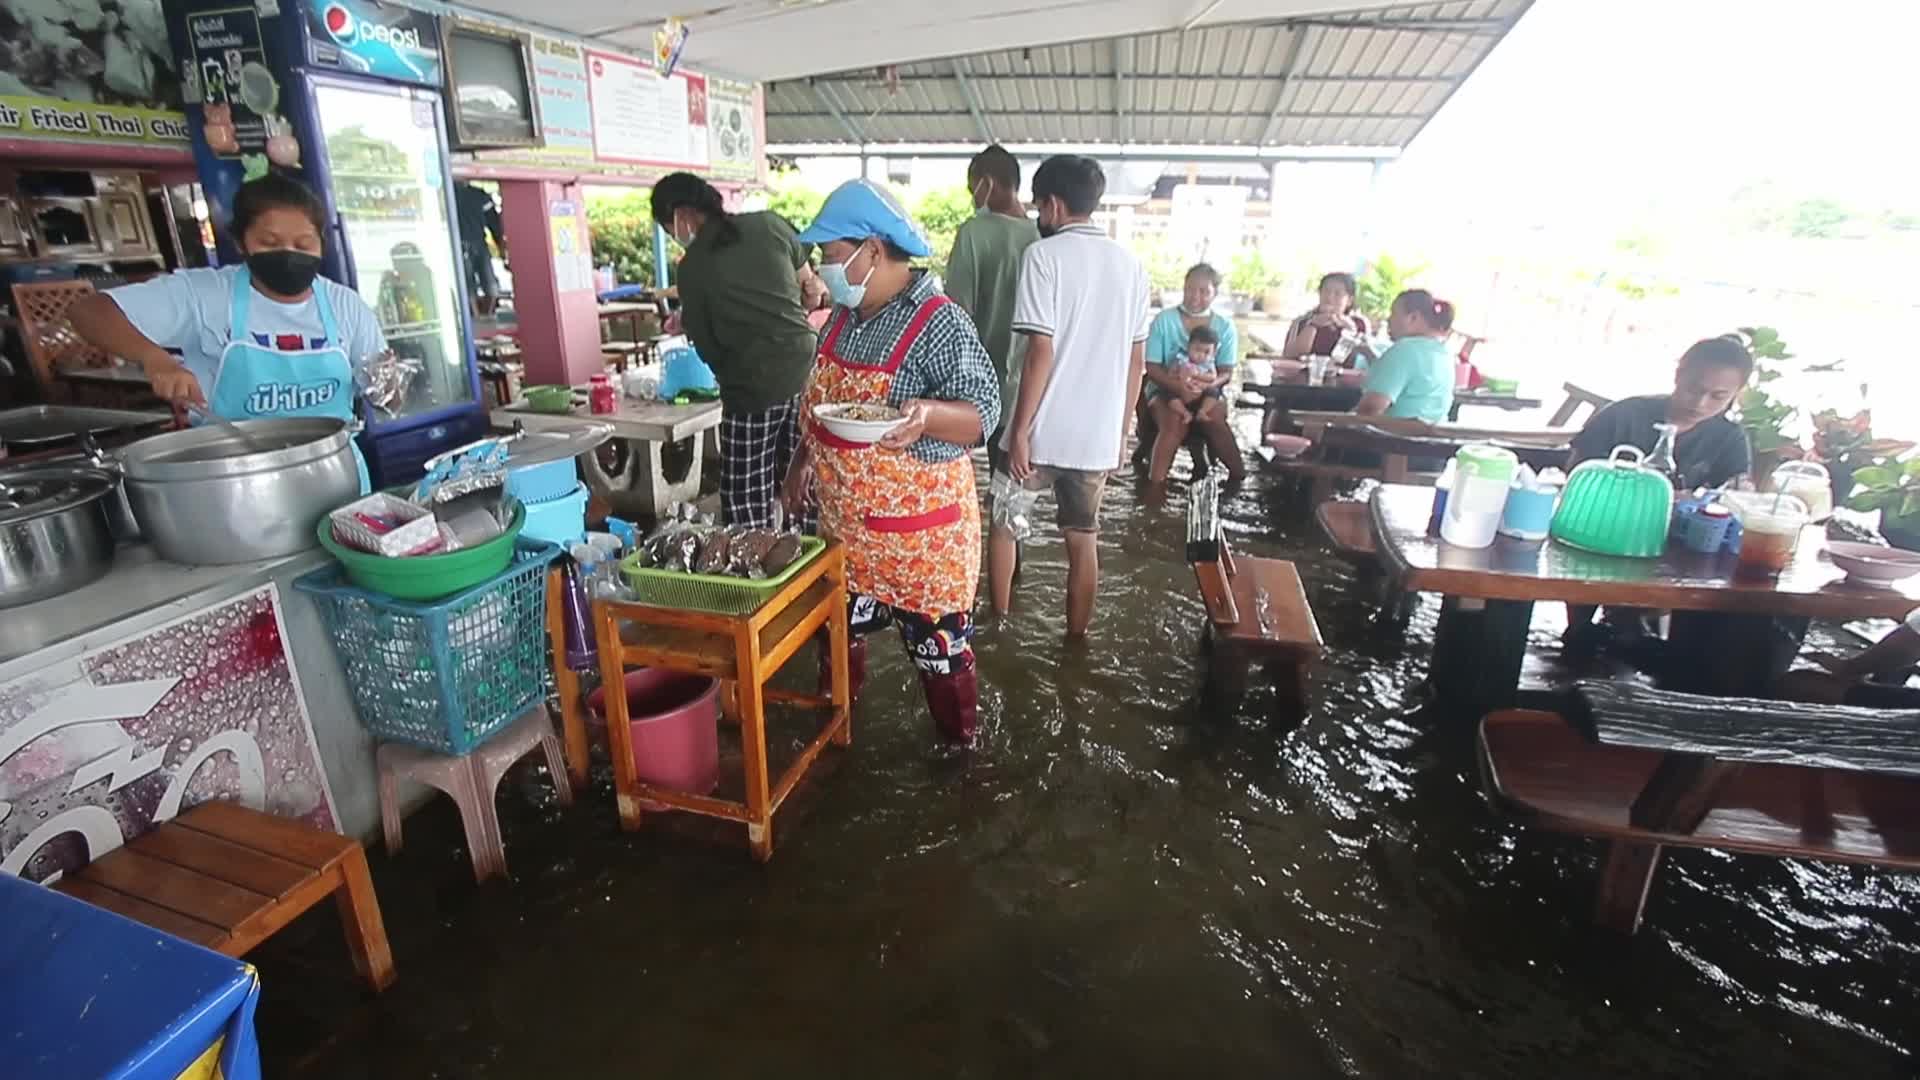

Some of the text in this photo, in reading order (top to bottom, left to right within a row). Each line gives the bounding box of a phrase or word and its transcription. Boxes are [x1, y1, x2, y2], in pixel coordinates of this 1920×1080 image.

[360, 20, 421, 51] pepsi
[0, 104, 18, 124] ir
[31, 108, 88, 130] Fried
[96, 113, 142, 134] Thai
[245, 380, 339, 414] ฟ้าไทย
